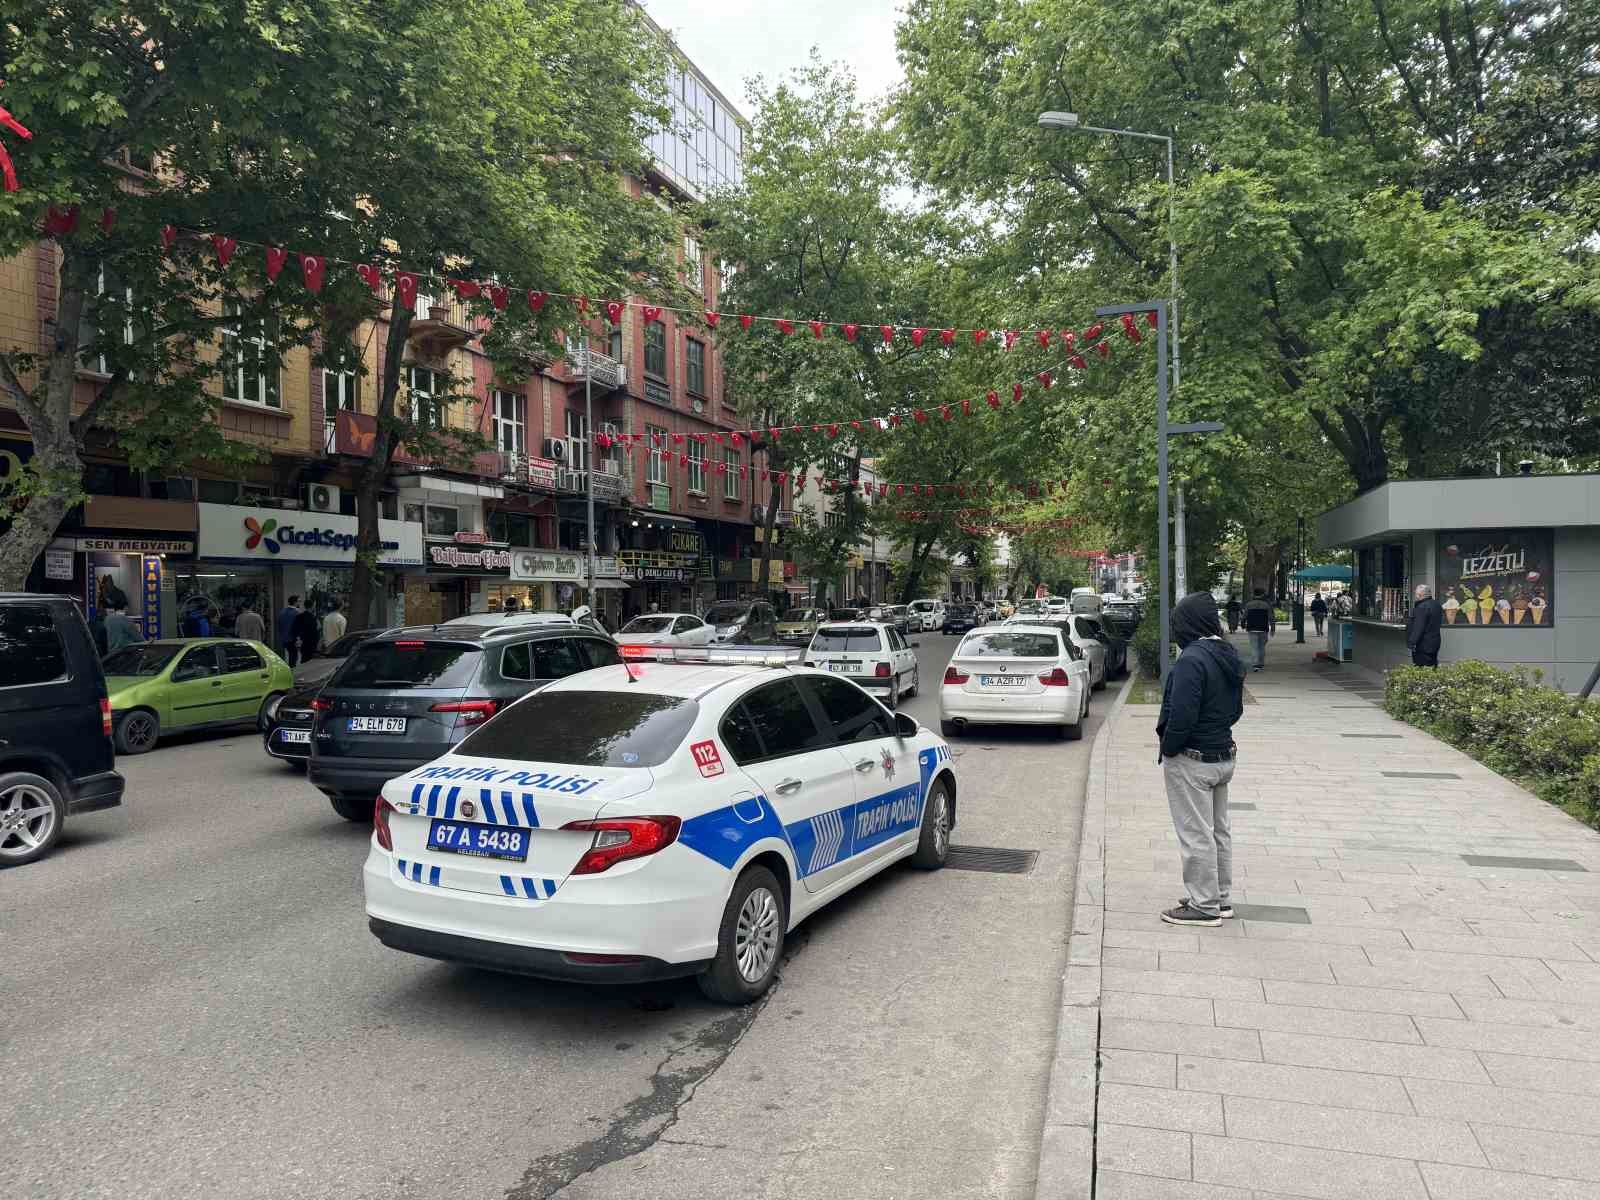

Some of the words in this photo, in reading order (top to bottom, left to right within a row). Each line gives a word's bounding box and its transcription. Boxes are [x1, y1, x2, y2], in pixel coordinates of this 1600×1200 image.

[85, 540, 113, 550] SEN
[276, 525, 399, 551] CicekSepcom
[352, 719, 364, 729] 34
[386, 719, 404, 730] 678
[696, 745, 716, 763] 112
[411, 766, 504, 783] TRAFİK
[502, 771, 603, 794] POLİSİ
[856, 800, 890, 840] TRAFİK
[888, 793, 918, 827] POLİSİ
[436, 825, 456, 844] 67
[458, 827, 471, 846] A
[477, 829, 521, 852] 5438
